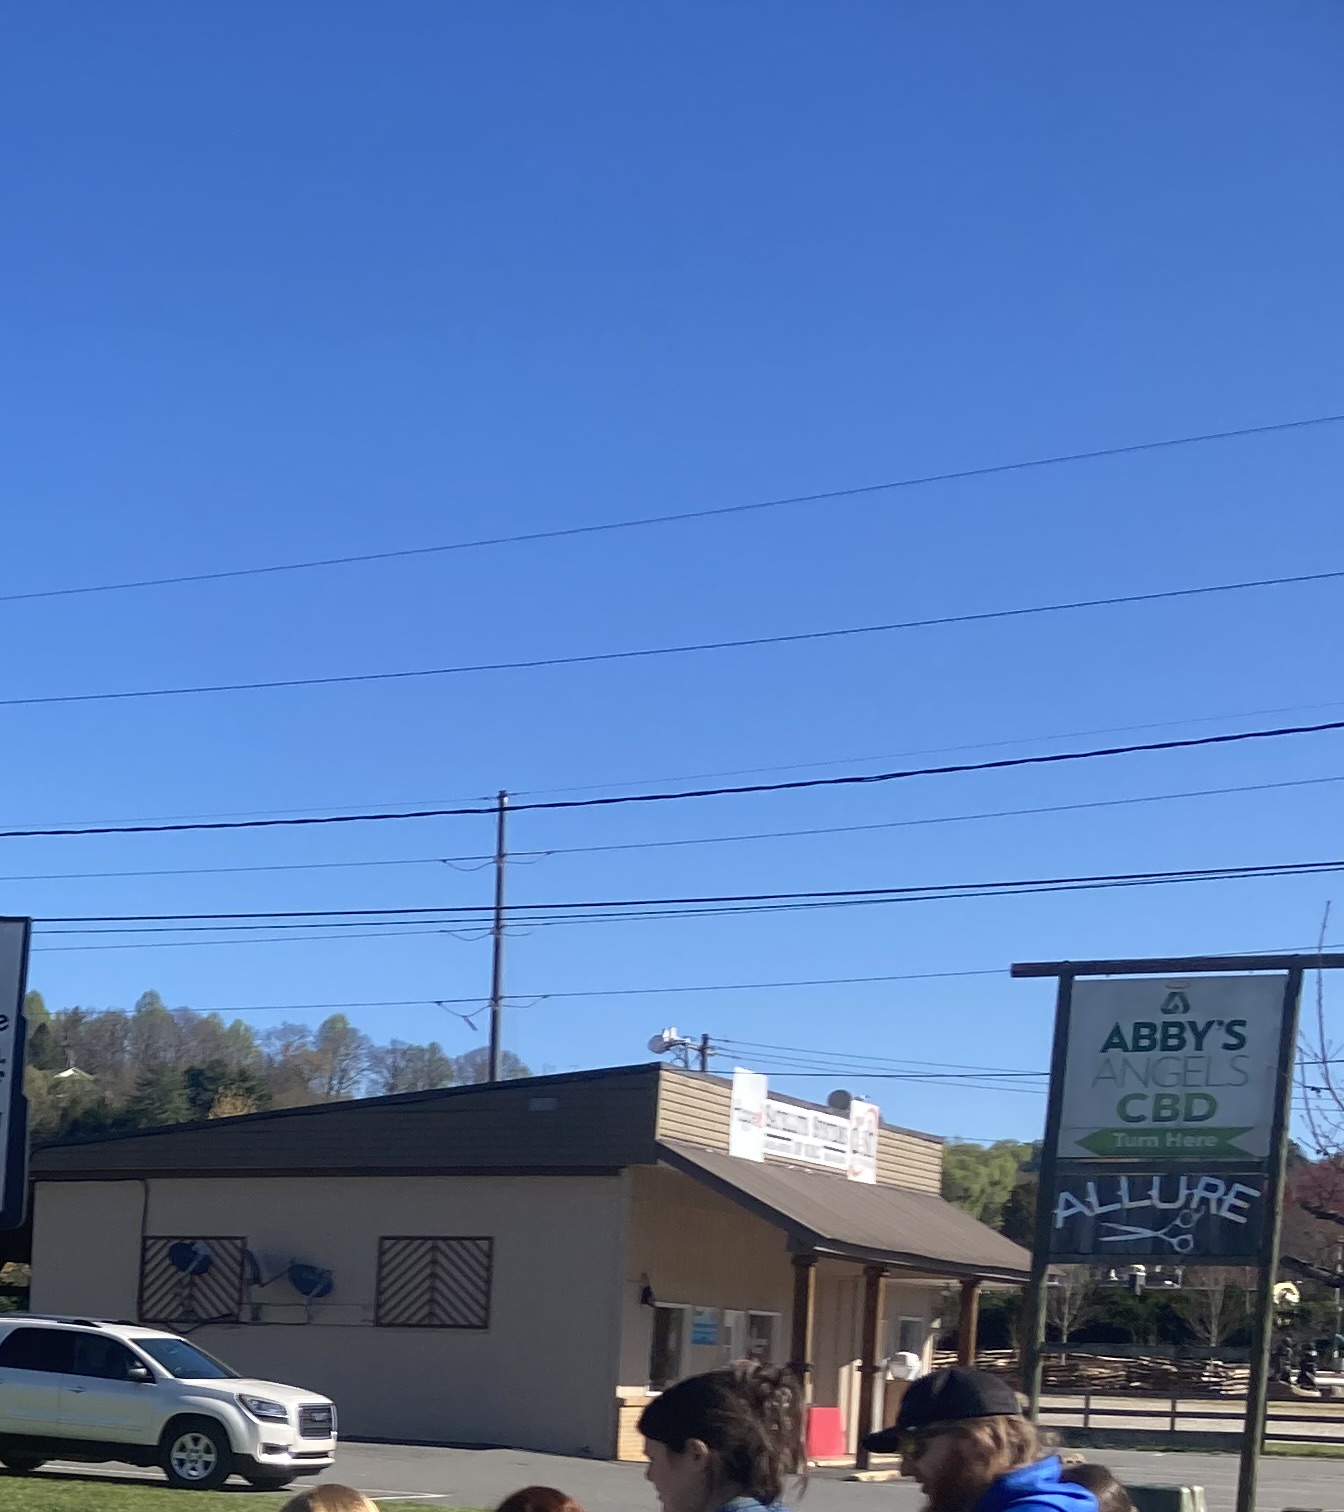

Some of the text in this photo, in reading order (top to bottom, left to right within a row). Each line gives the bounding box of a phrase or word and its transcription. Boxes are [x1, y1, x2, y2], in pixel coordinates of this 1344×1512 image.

[1100, 1019, 1247, 1053] ABBY'S
[1091, 1054, 1250, 1089] ANGELS
[1116, 1092, 1219, 1124] CBD
[1114, 1131, 1218, 1149] Turn Here
[1052, 1174, 1262, 1230] ALLURE
